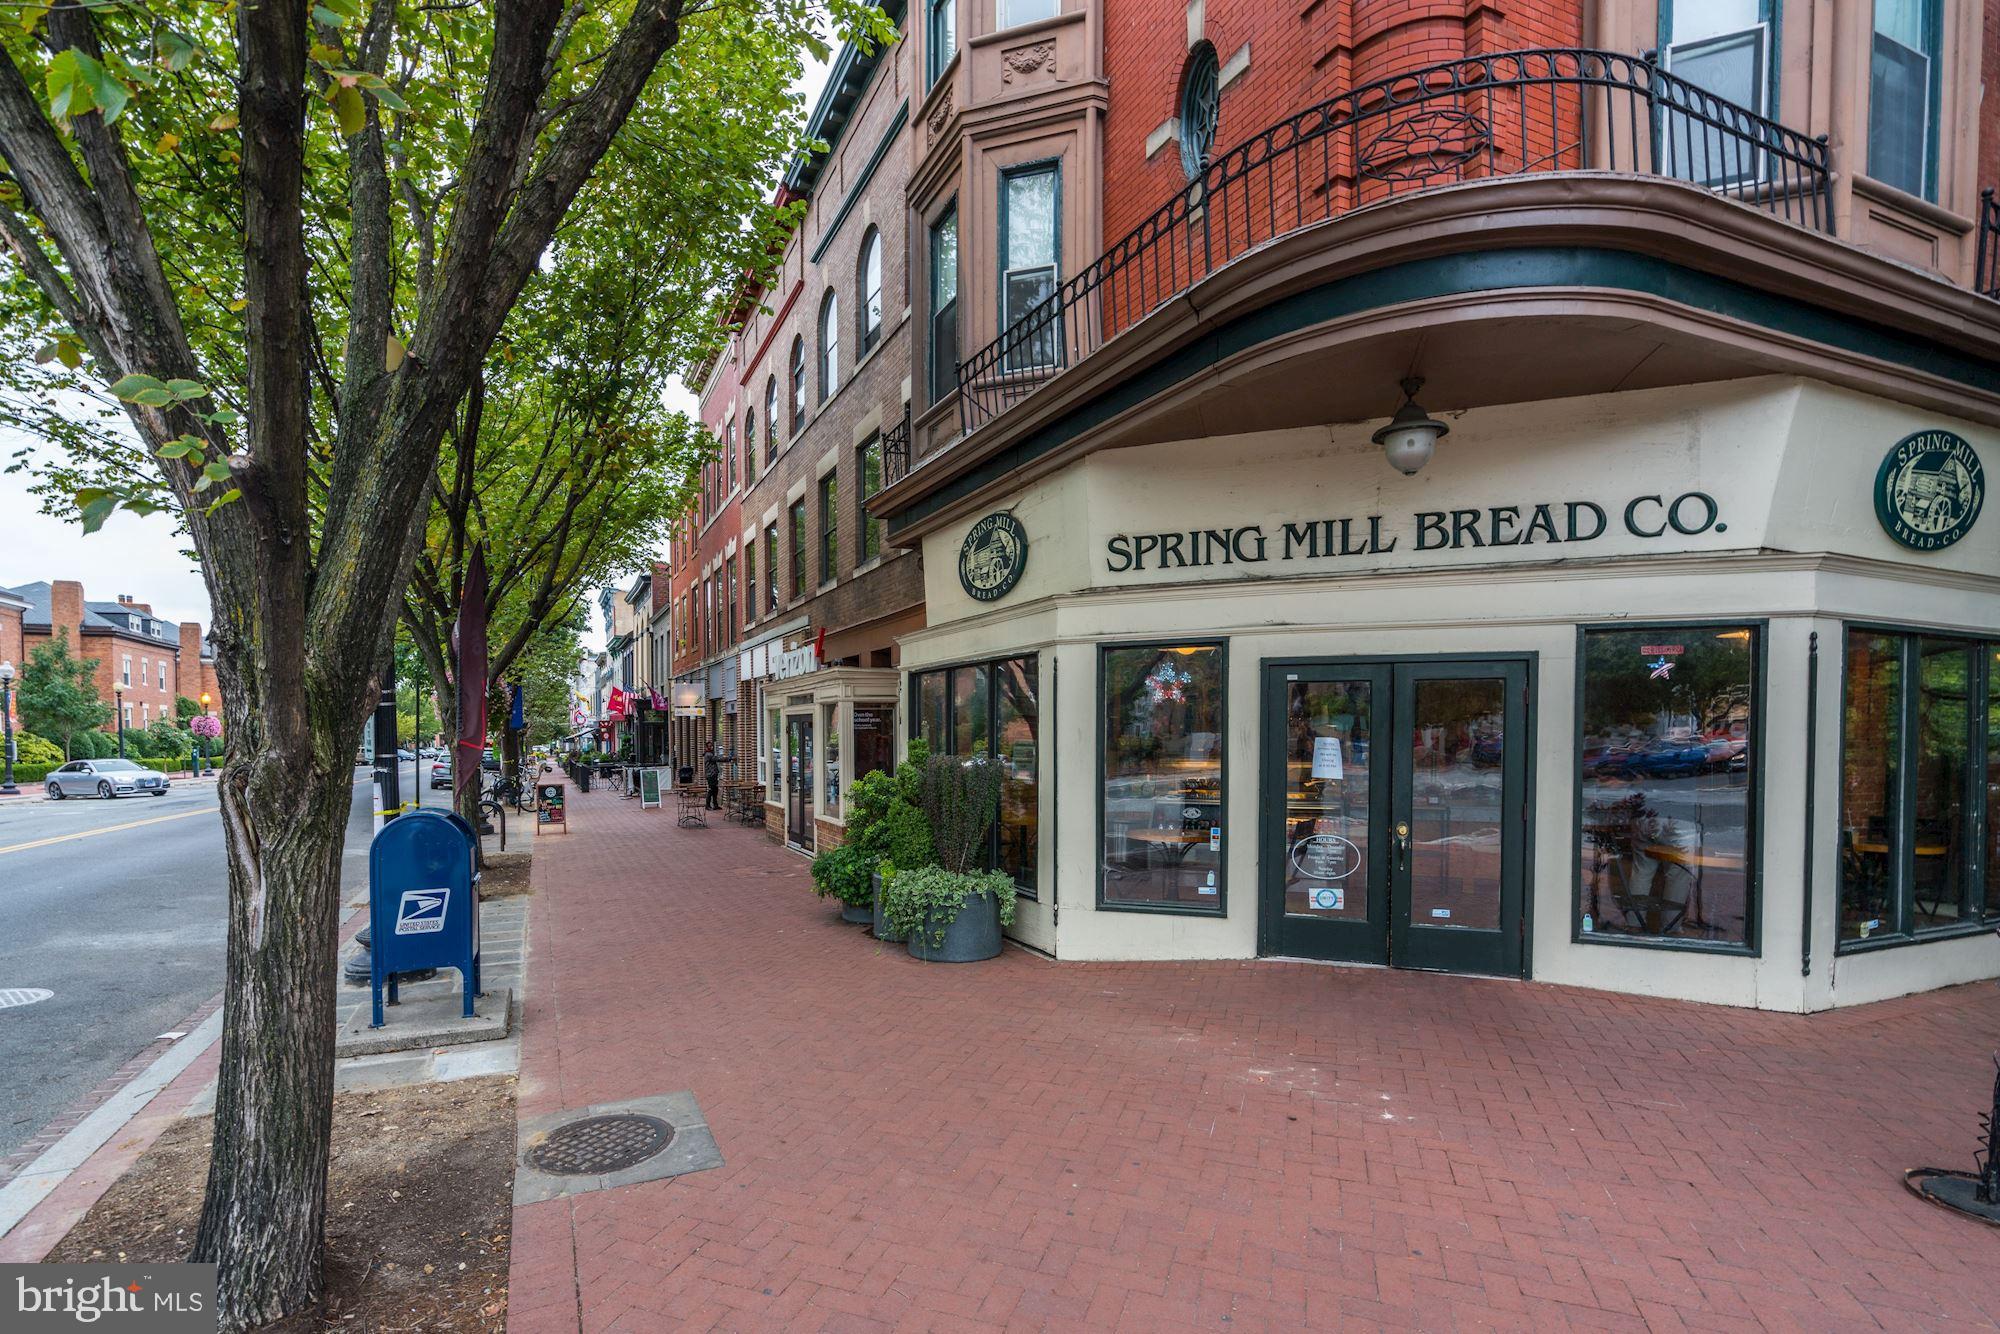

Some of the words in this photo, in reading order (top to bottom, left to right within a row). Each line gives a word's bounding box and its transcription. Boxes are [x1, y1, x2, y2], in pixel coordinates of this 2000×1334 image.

[1897, 434, 1951, 467] SPRING
[1953, 440, 1981, 483] MILL
[963, 517, 993, 556] SPRING
[995, 515, 1016, 537] MILL
[1106, 525, 1268, 572] SPRING
[1278, 515, 1397, 560] MILL
[1413, 500, 1607, 550] BREAD
[1624, 492, 1728, 538] CO.
[1894, 520, 1935, 548] BREAD
[971, 588, 998, 599] BREAD
[772, 641, 817, 680] verizon
